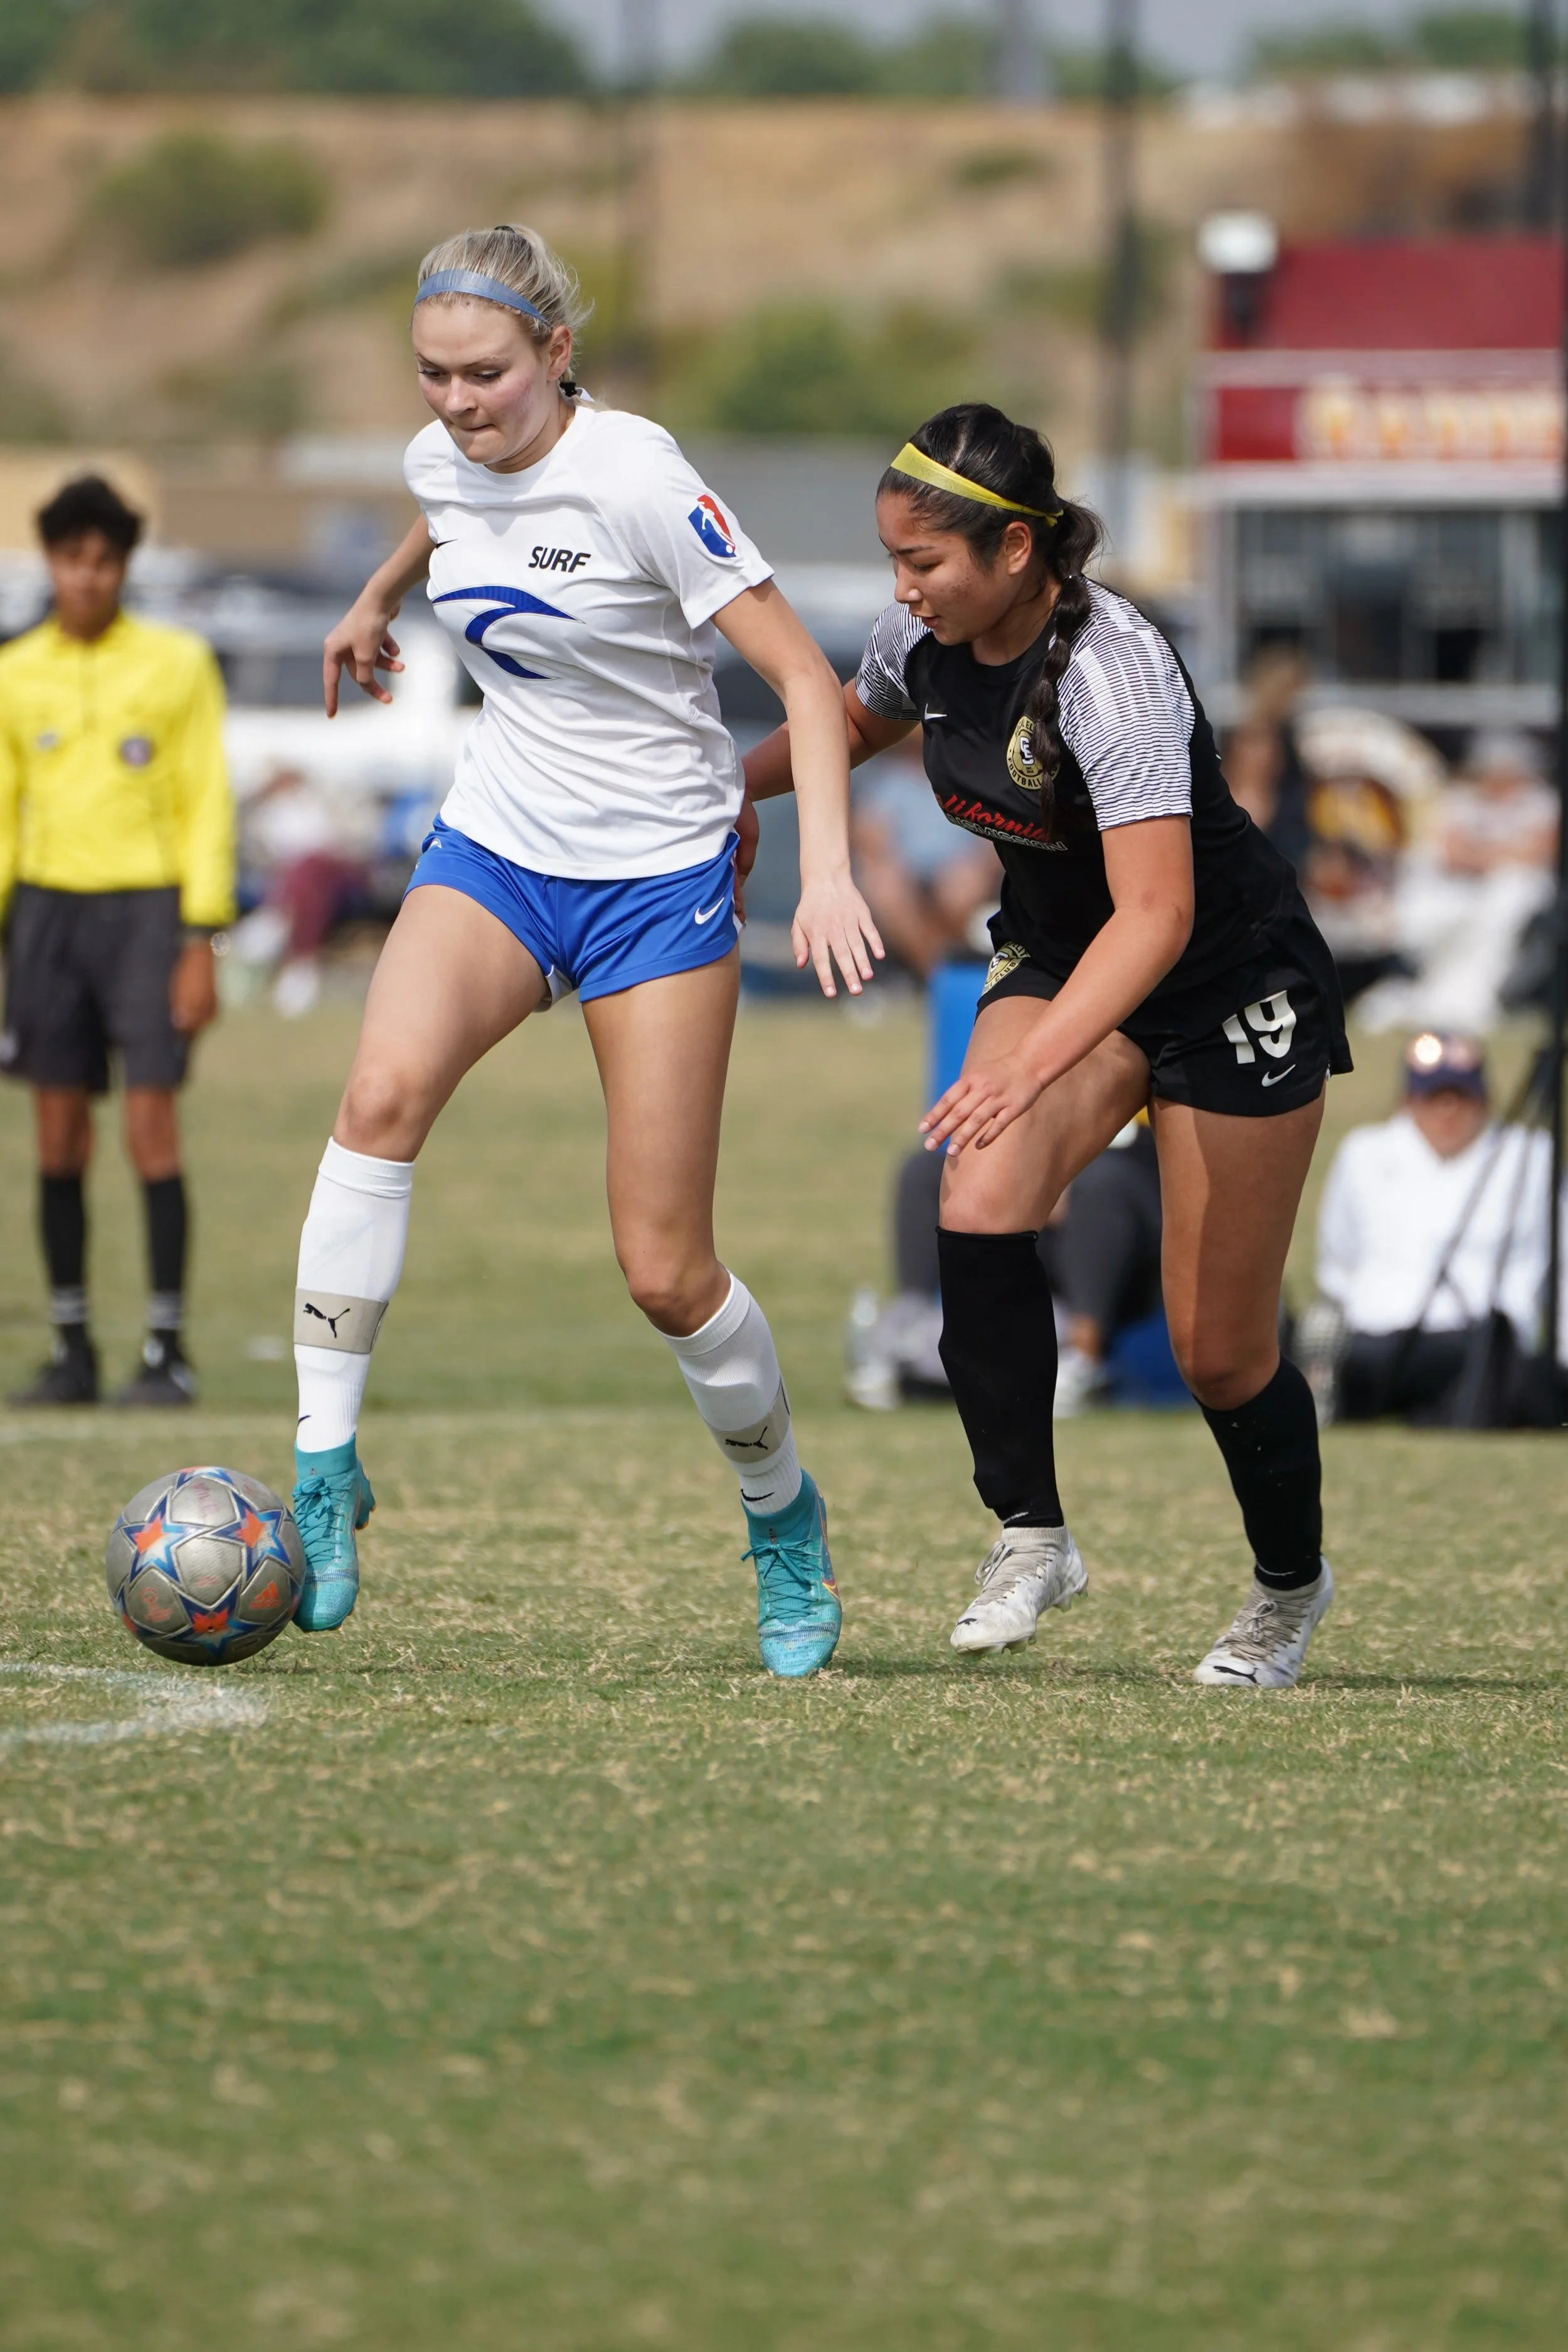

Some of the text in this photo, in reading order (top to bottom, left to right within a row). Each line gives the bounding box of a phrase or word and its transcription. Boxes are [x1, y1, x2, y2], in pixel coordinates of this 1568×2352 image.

[528, 546, 591, 573] SURF
[995, 962, 1016, 982] CLUB
[1222, 990, 1296, 1064] 19
